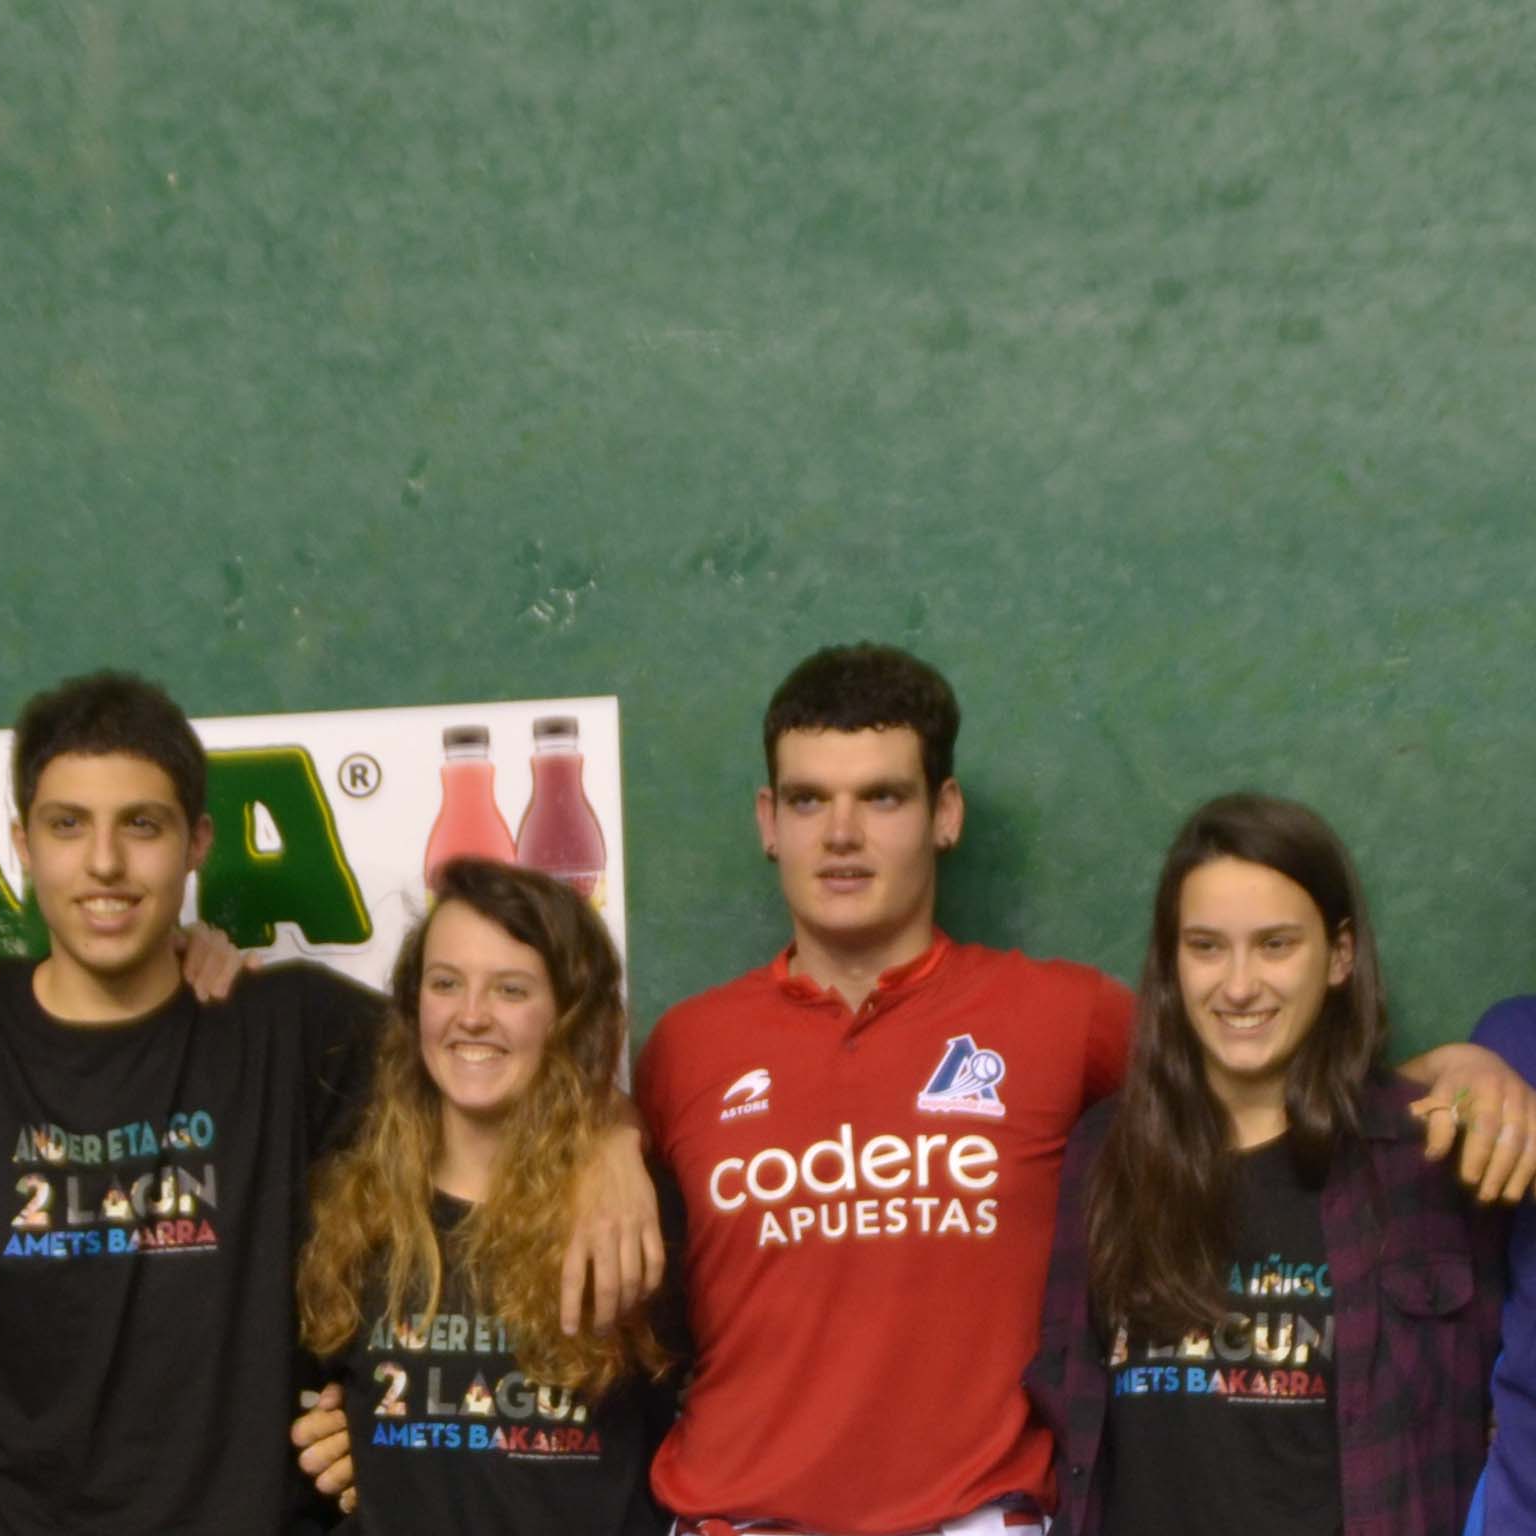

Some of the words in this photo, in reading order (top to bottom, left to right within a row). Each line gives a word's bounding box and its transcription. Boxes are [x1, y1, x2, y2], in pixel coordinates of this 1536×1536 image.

[106, 1120, 160, 1162] ETA
[709, 1123, 1000, 1211] codere
[11, 1174, 53, 1227] 2
[757, 1197, 999, 1247] APUESTAS
[2, 1230, 102, 1258] AMETS
[373, 1360, 408, 1415] 2
[1185, 1366, 1329, 1396] BAKARRA
[371, 1423, 462, 1450] AMETS
[468, 1424, 602, 1453] BAKARRA
